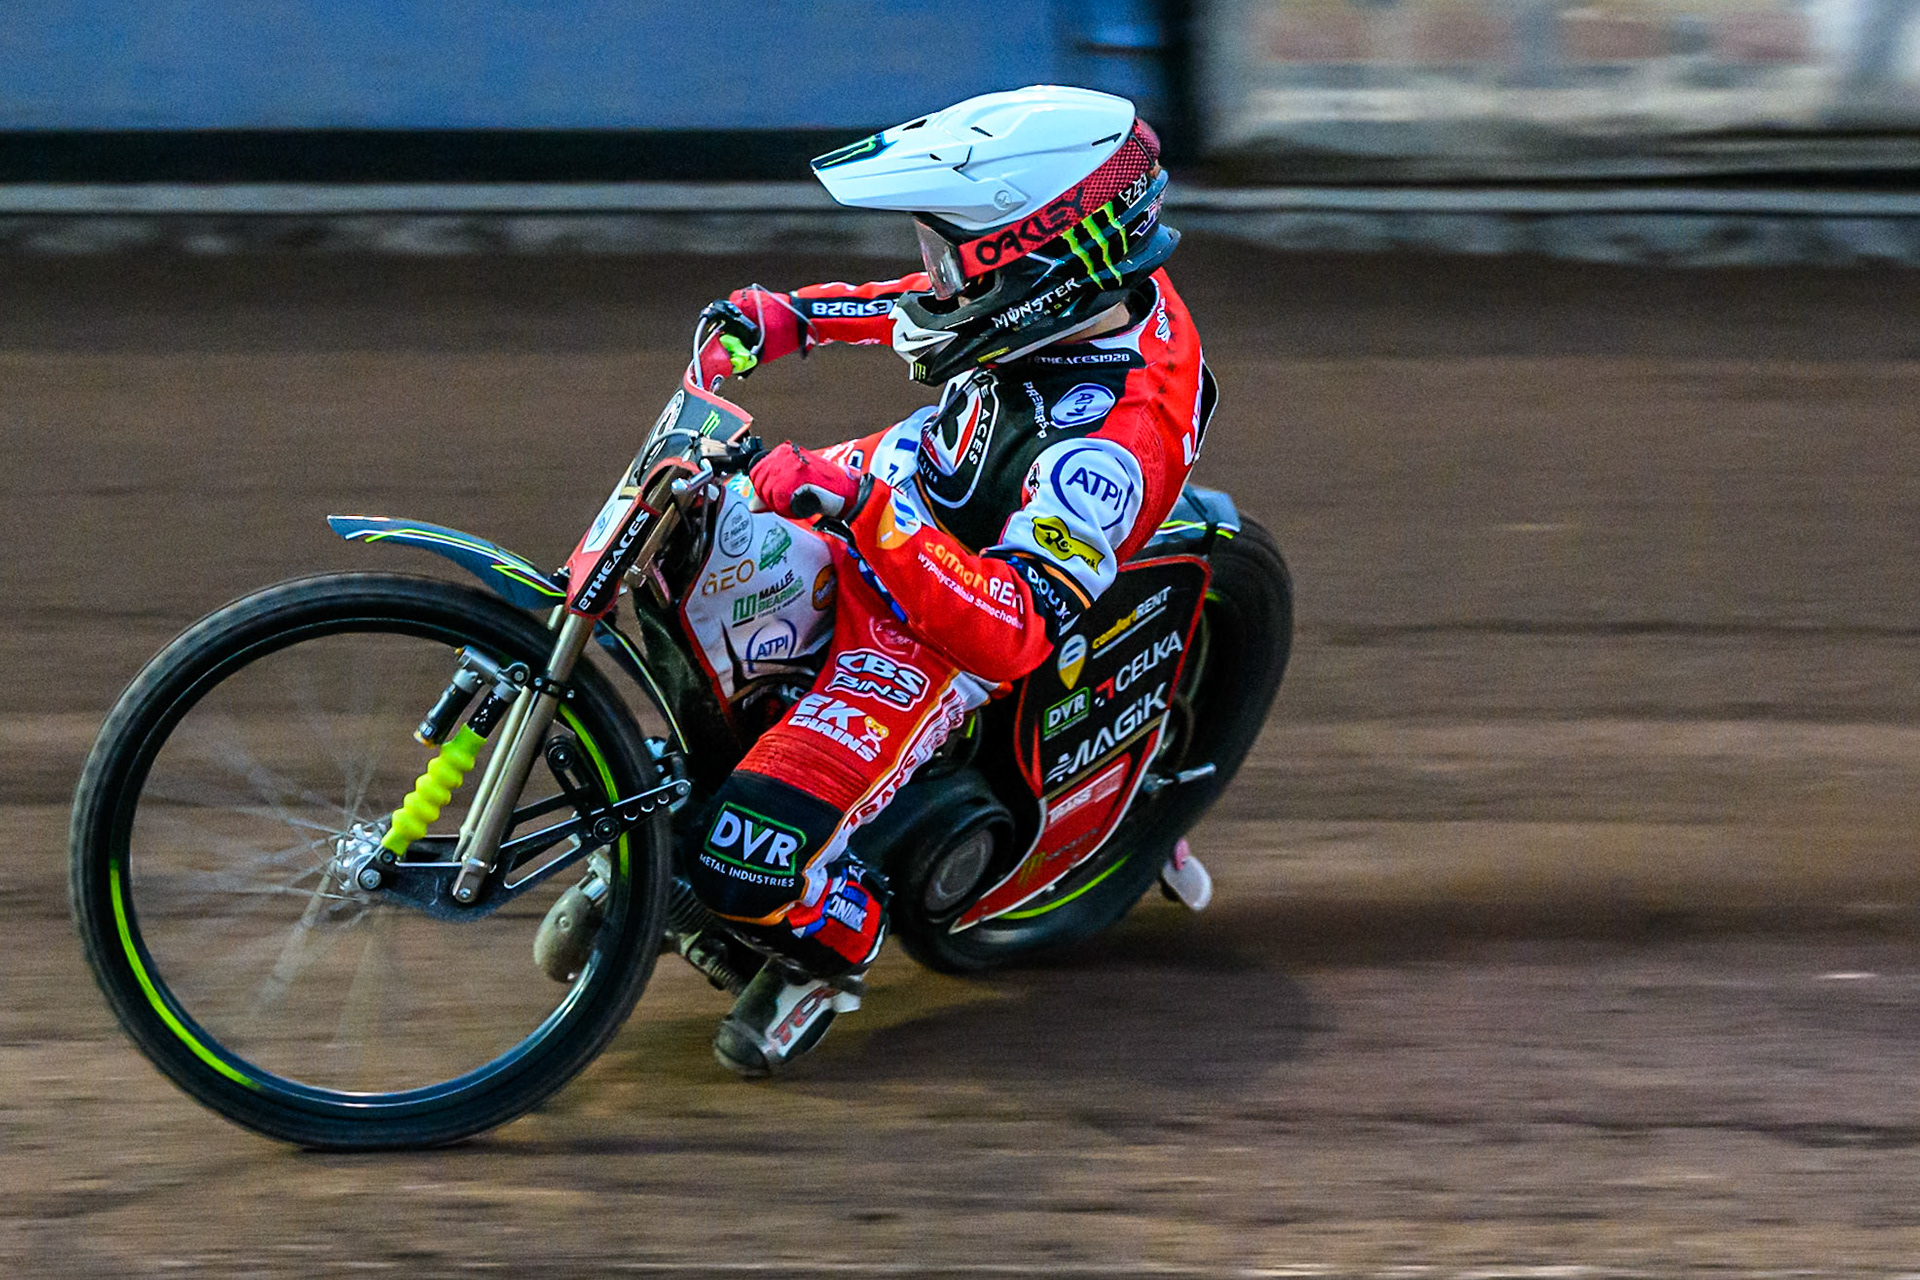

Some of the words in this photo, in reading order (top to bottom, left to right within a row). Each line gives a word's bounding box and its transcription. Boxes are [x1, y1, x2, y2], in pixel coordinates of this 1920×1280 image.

[976, 186, 1084, 265] OAKLEY
[1065, 466, 1123, 511] ATPI
[756, 633, 789, 660] ATPI
[1115, 630, 1184, 692] CELKA
[830, 672, 911, 704] BINS
[838, 653, 924, 696] CBS
[794, 693, 867, 732] EK
[1048, 693, 1086, 728] DVR
[787, 715, 878, 763] CHAINS
[711, 810, 798, 868] DVR
[699, 853, 726, 874] METAL
[728, 866, 795, 888] INDUSTRIES
